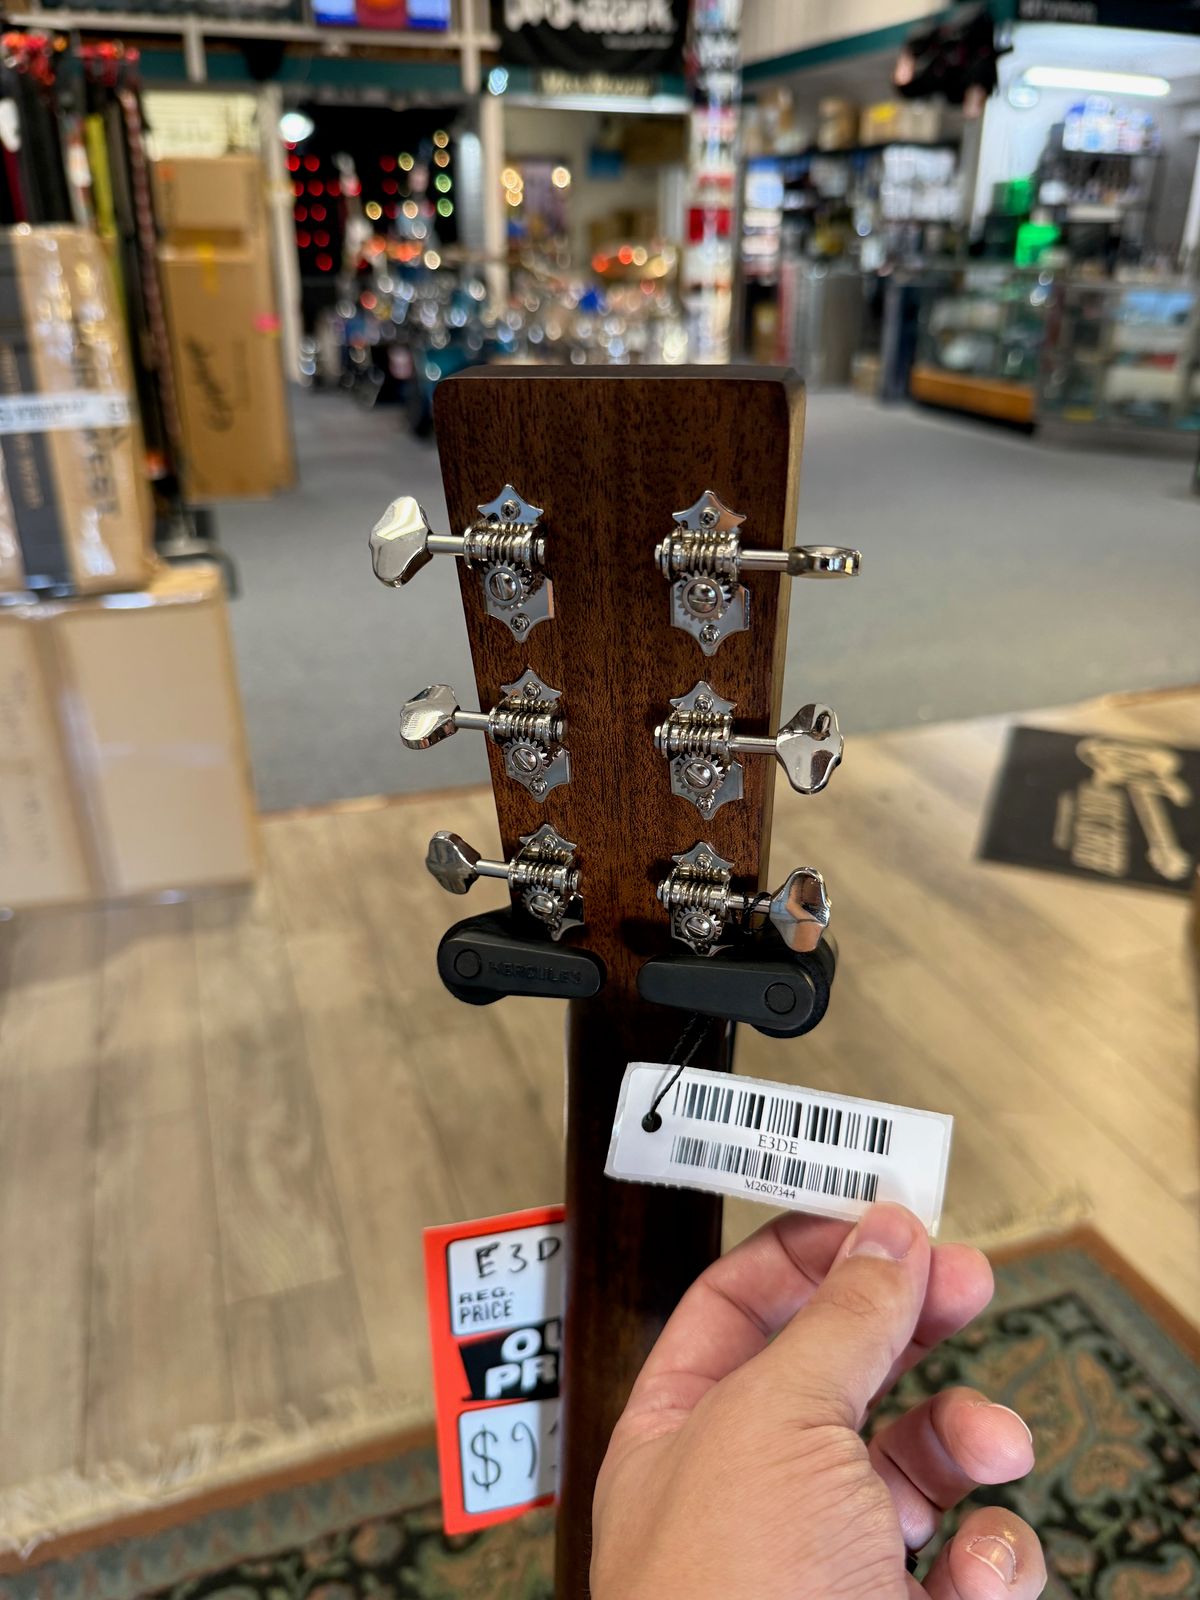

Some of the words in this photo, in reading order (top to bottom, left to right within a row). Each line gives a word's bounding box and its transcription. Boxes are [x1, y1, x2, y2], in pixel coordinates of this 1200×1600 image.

[758, 1134, 799, 1155] E3DE
[744, 1178, 797, 1199] M2607344
[459, 1300, 513, 1324] PRICE
